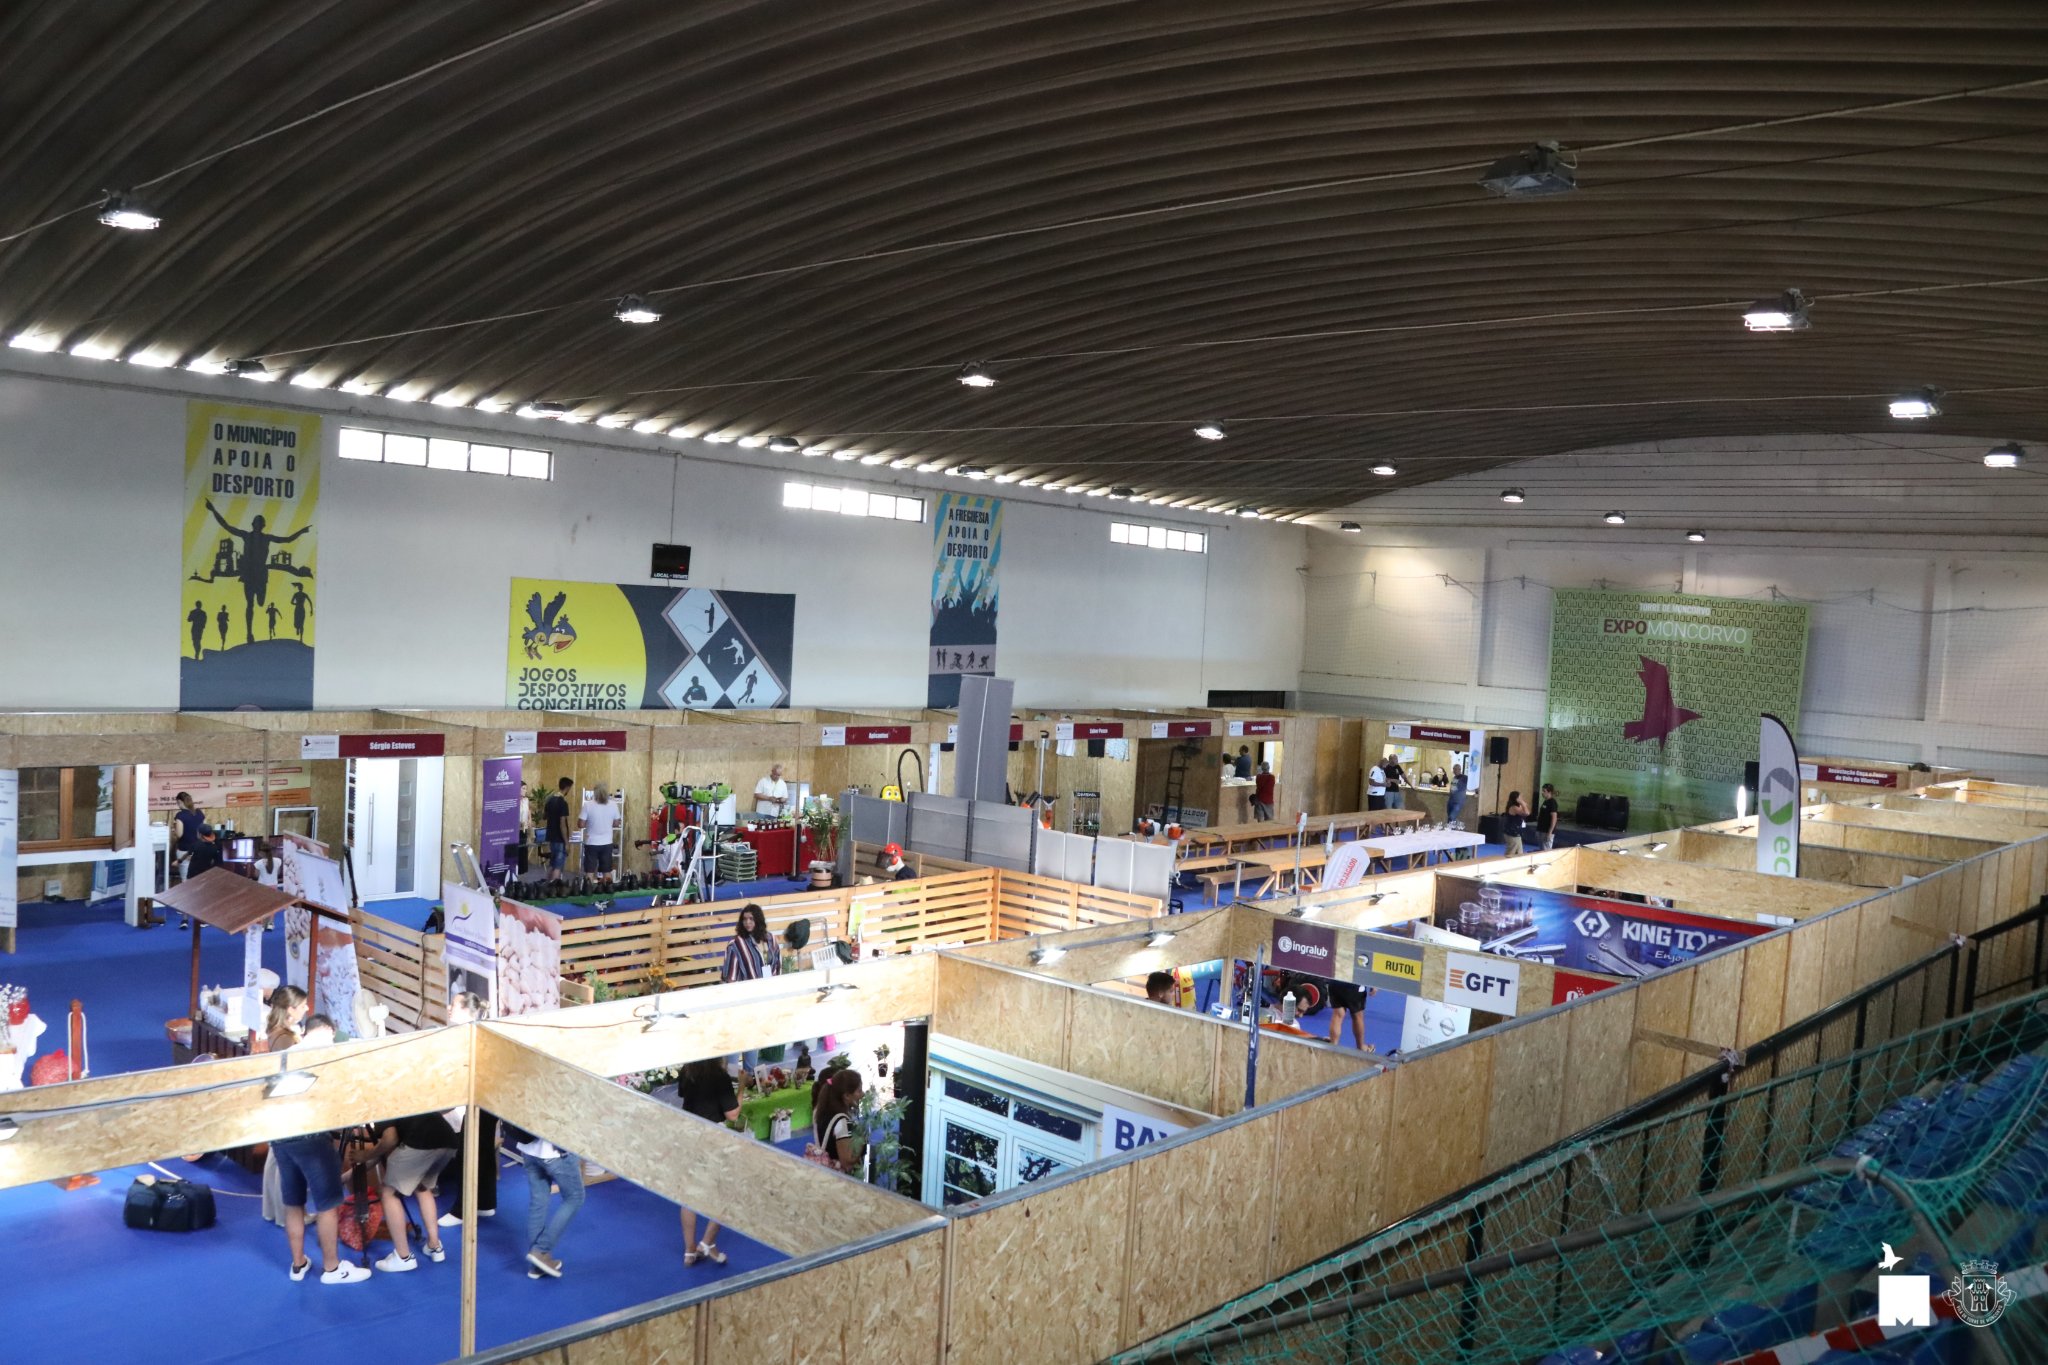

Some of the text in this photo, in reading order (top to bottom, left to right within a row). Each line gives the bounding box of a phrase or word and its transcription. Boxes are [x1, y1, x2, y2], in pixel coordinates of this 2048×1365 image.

[214, 423, 296, 448] O MUNICÍPIO
[213, 447, 295, 472] APOIA O
[212, 473, 294, 499] DESPORTO
[949, 508, 989, 525] A FREGUESIA
[948, 525, 989, 541] APOIA O
[947, 542, 988, 560] DESPORTO
[1648, 638, 1745, 654] EXPOSIÇÃO DE EMPRESAS
[519, 667, 577, 682] JOGOS
[518, 682, 626, 698] DESPORTIVOS
[369, 741, 416, 751] Sérgio Esteves
[1622, 920, 1672, 947] KING
[1292, 940, 1328, 957] ingralub
[1385, 960, 1416, 976] RUTOL
[1466, 972, 1511, 997] GFT
